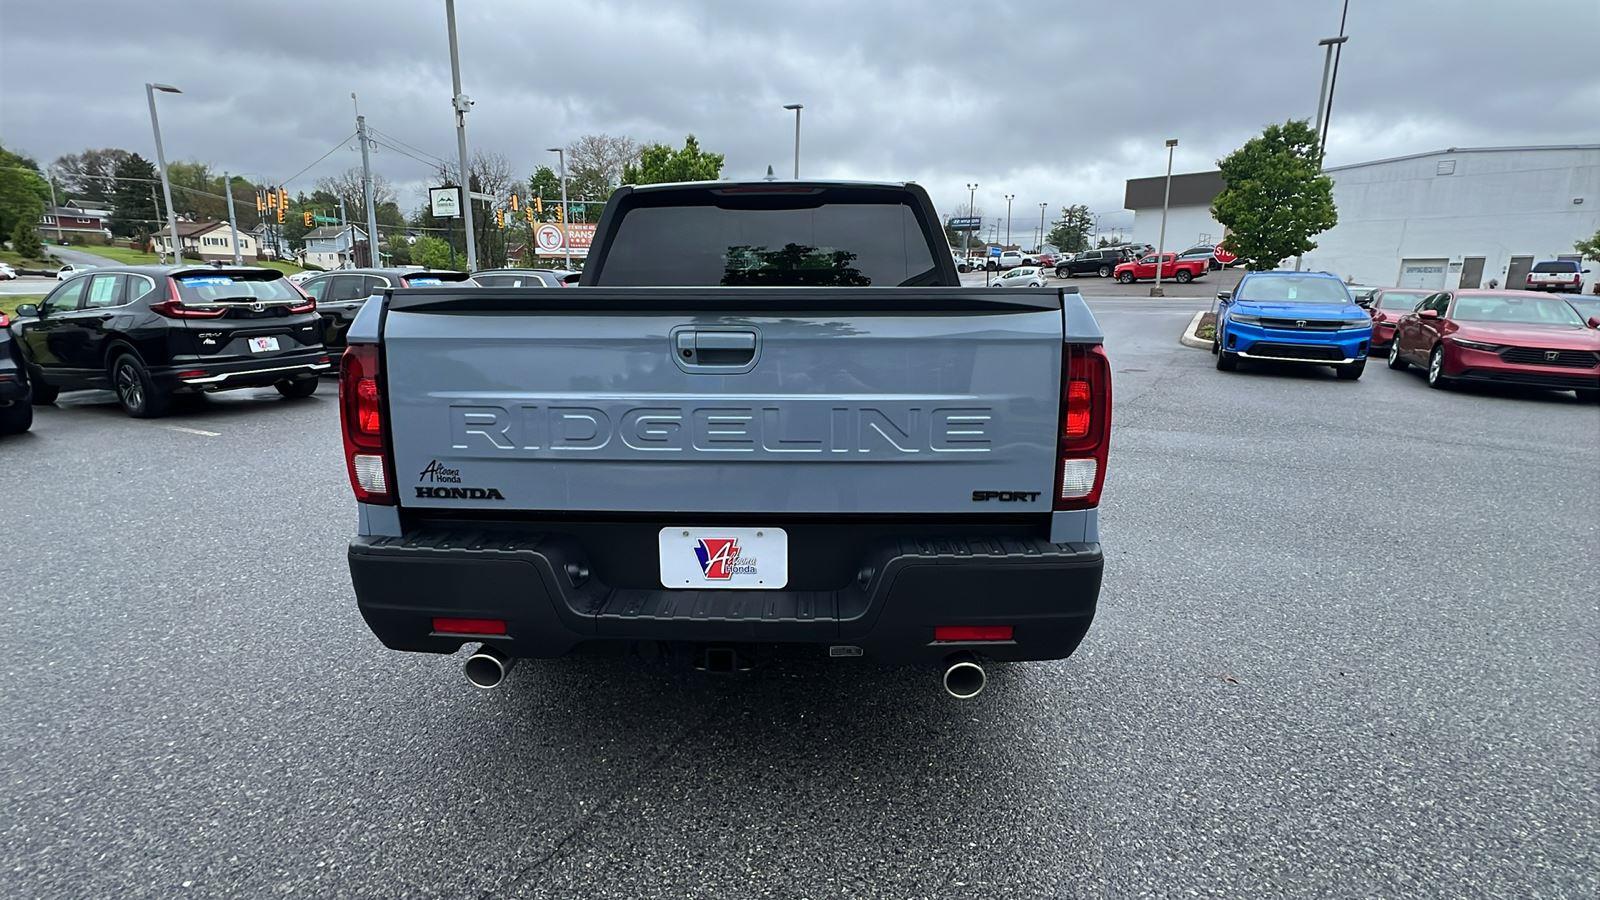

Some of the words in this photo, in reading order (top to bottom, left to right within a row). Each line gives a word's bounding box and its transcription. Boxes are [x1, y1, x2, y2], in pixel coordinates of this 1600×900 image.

[563, 231, 595, 239] RANS
[449, 405, 993, 454] RIDGELINE
[436, 475, 462, 483] Honda
[415, 487, 506, 500] HONDA
[972, 491, 1042, 502] SPORT
[725, 564, 757, 574] Honda
